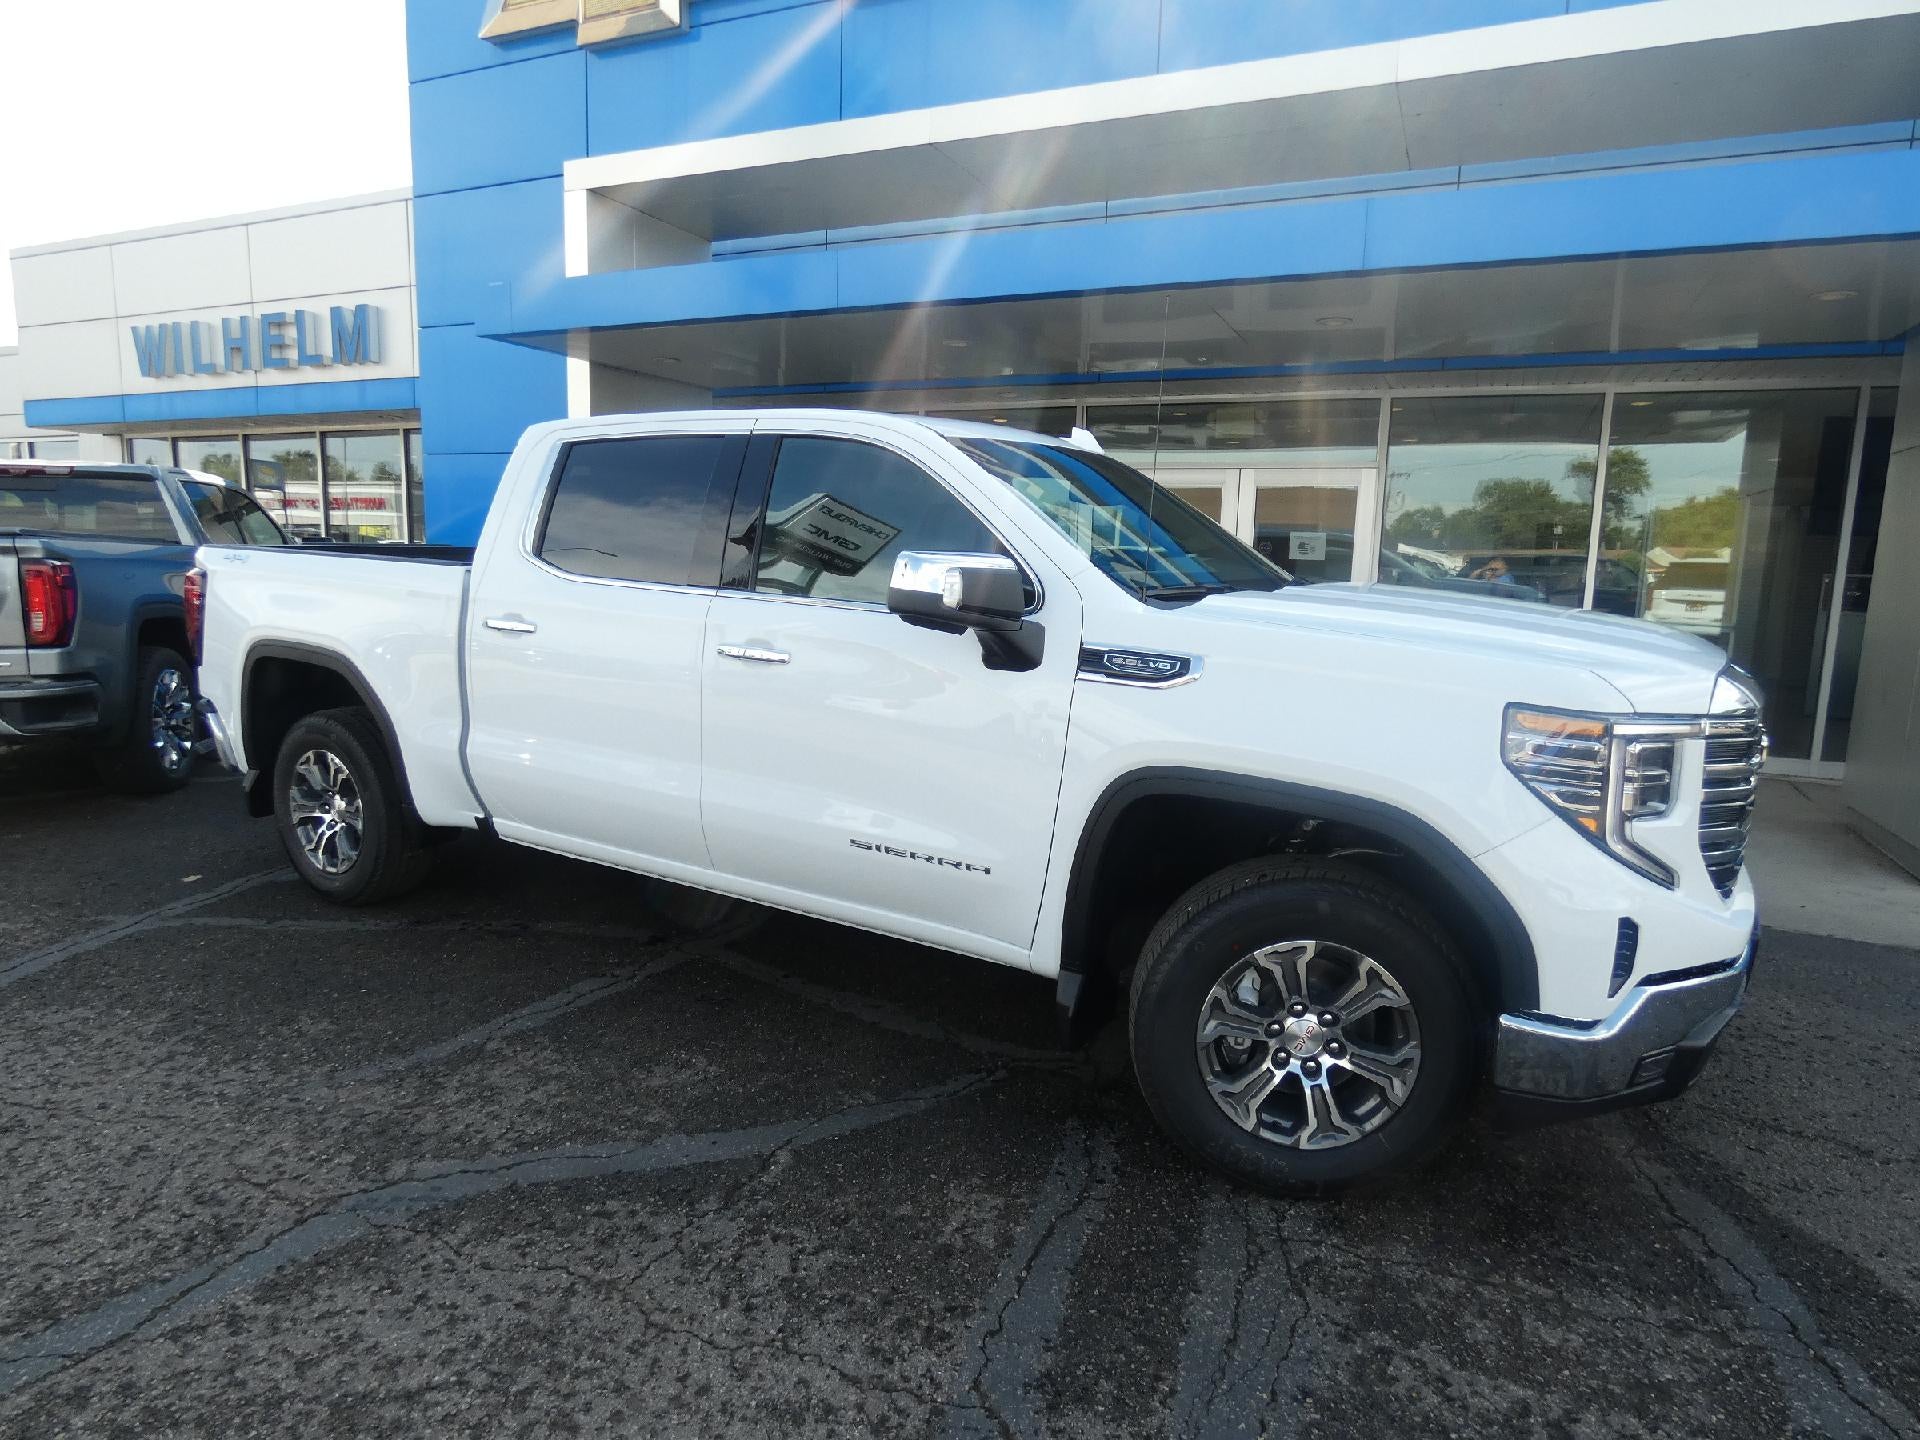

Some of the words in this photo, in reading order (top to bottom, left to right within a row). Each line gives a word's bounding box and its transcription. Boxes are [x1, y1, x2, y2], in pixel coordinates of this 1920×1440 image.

[131, 304, 379, 378] WILHELM
[849, 839, 991, 875] SIERRA
[1294, 1026, 1314, 1051] GMC
